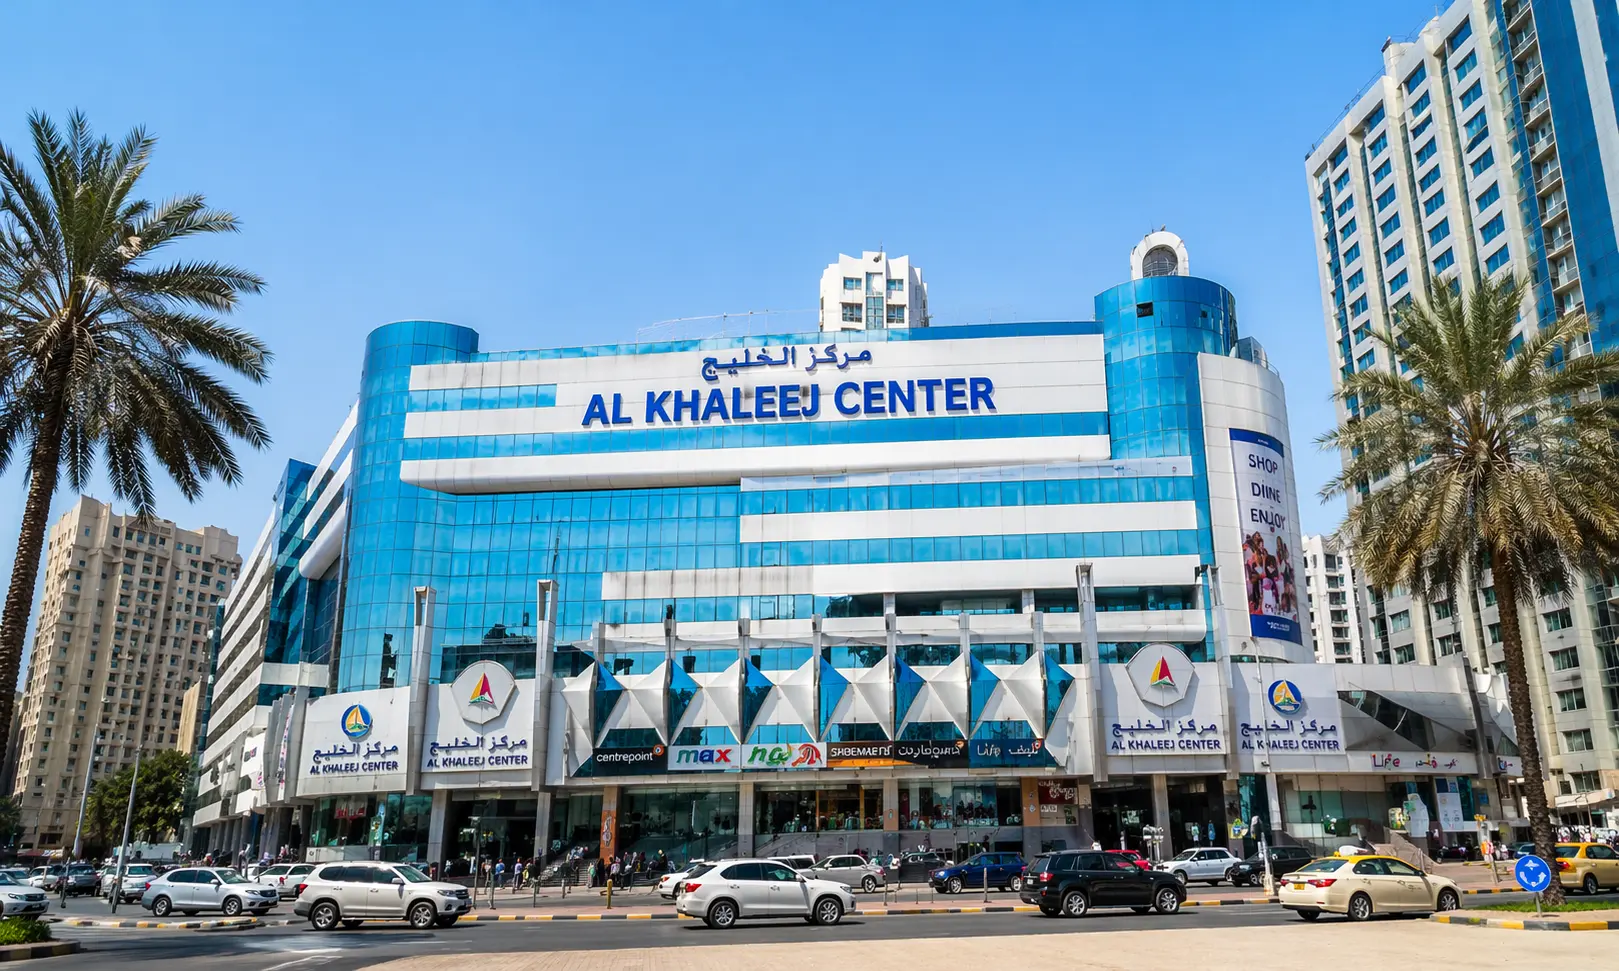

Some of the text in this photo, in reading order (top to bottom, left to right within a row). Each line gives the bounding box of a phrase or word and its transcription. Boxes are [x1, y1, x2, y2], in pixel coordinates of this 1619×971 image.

[701, 343, 872, 382] مركز الخليج
[581, 376, 996, 426] AL KHALEEJ CENTER
[1248, 453, 1278, 474] SHOP
[1250, 508, 1286, 530] ENJOY
[1112, 719, 1217, 737] مركز الخليج
[1300, 718, 1337, 735] مركز
[313, 740, 398, 764] مركز الخليج
[430, 735, 527, 755] مركز الخليج
[1111, 739, 1221, 750] AL KHALEEJ CENTER
[1241, 740, 1254, 750] AL
[1302, 740, 1340, 750] CENTER
[427, 755, 528, 768] AL KHALEEJ CENTER
[596, 752, 653, 764] centrepoint
[676, 748, 732, 764] max
[310, 761, 398, 775] AL KHALEEJ CENTER
